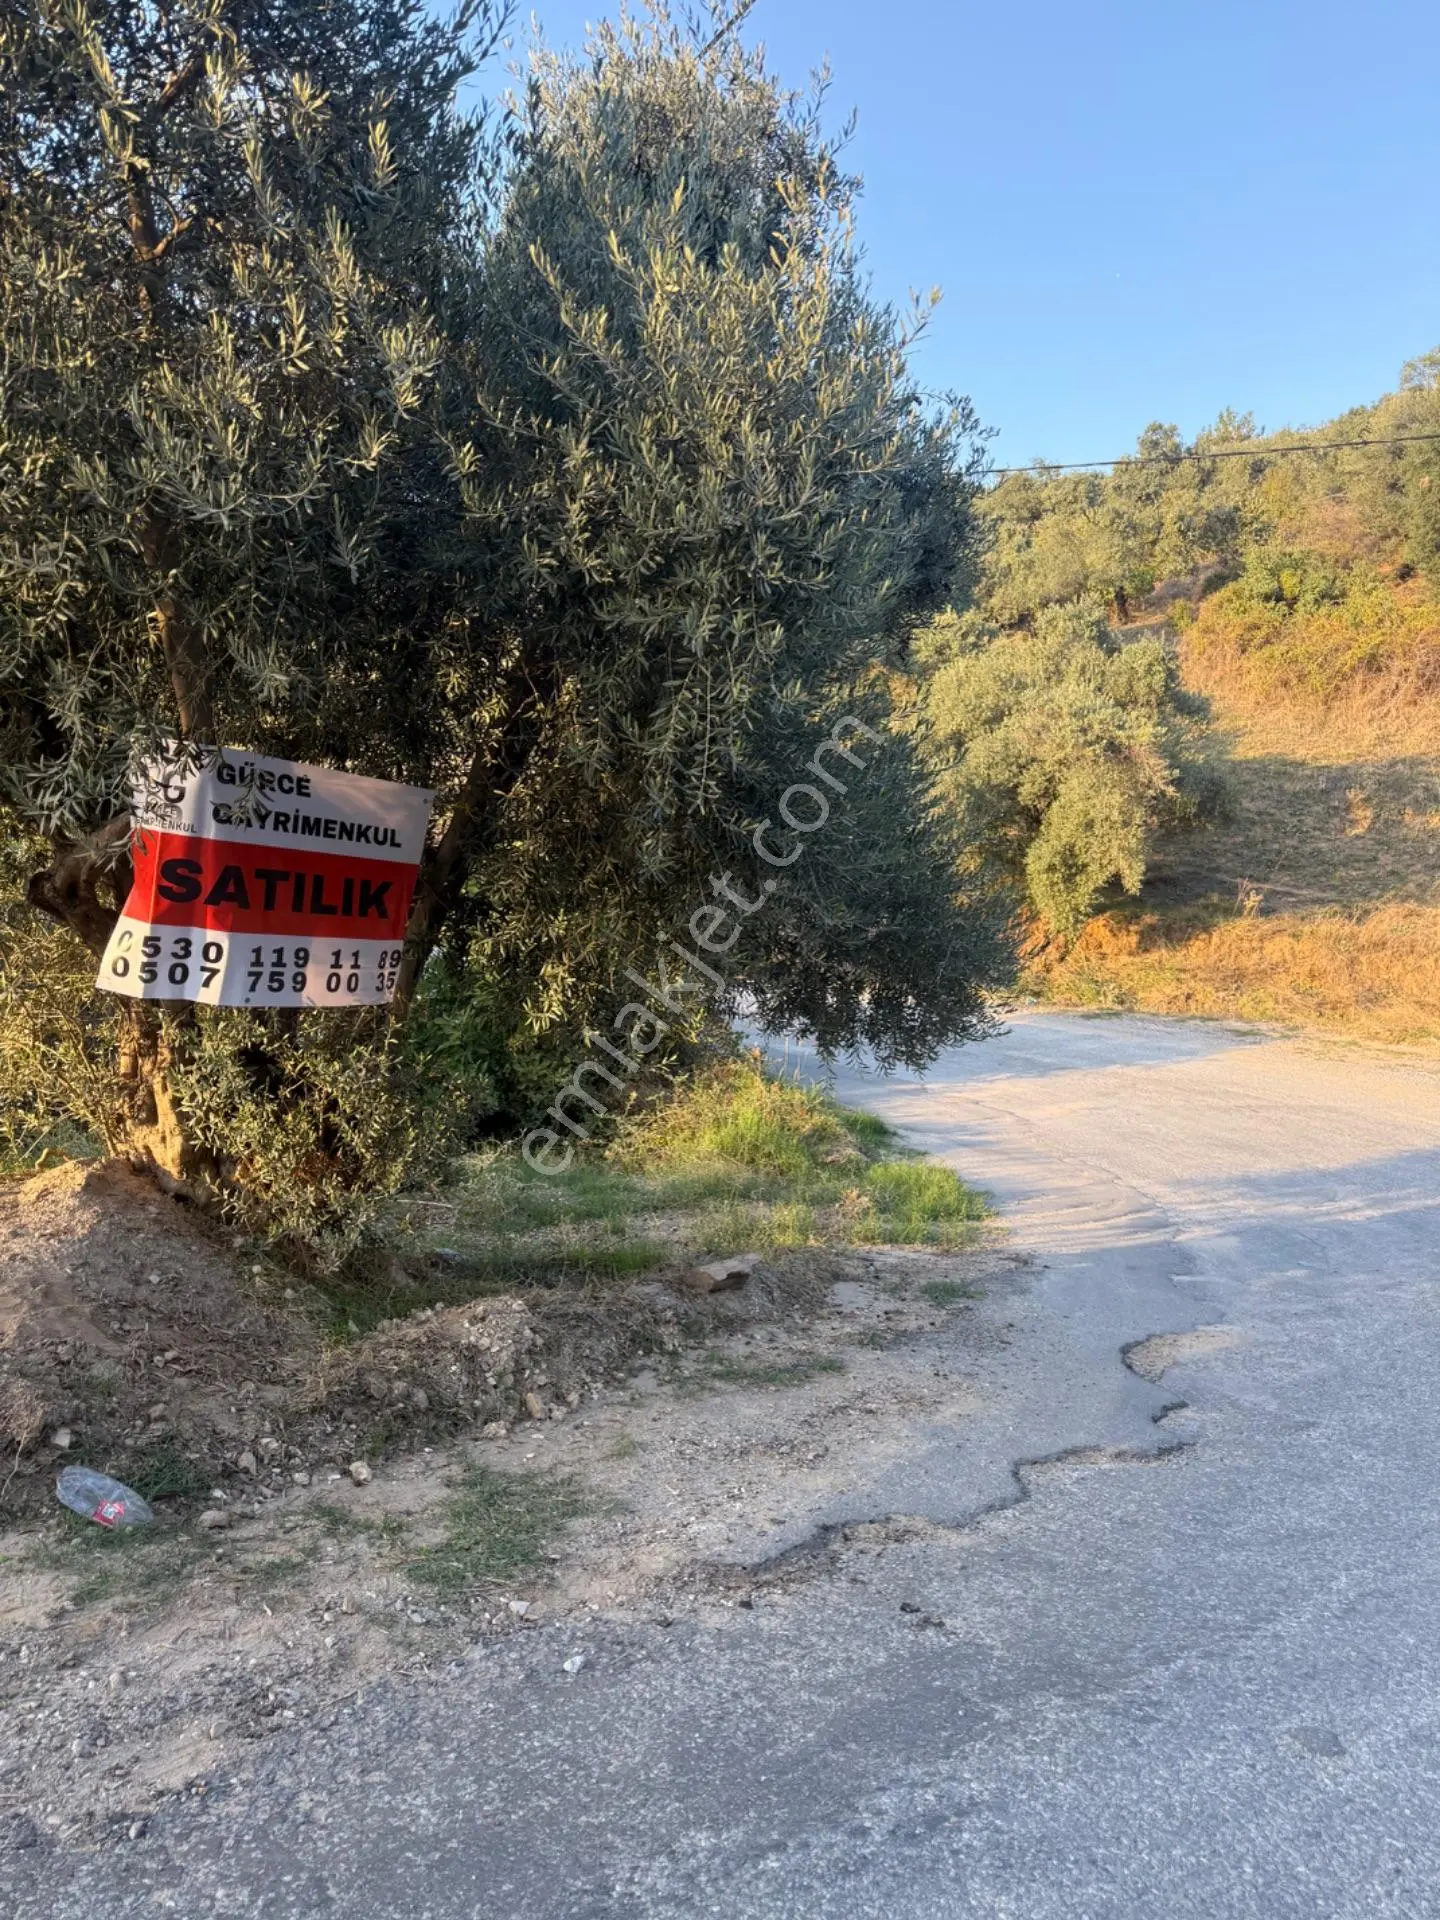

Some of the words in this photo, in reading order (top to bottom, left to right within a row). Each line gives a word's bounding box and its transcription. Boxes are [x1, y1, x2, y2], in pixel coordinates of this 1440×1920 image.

[217, 762, 311, 798] GÜRCE
[156, 858, 393, 919] SATILIK
[250, 945, 310, 968] 119
[330, 949, 361, 970] 11
[378, 949, 402, 970] 89
[247, 971, 307, 993] 759
[326, 972, 359, 993] 00
[375, 971, 397, 993] 35
